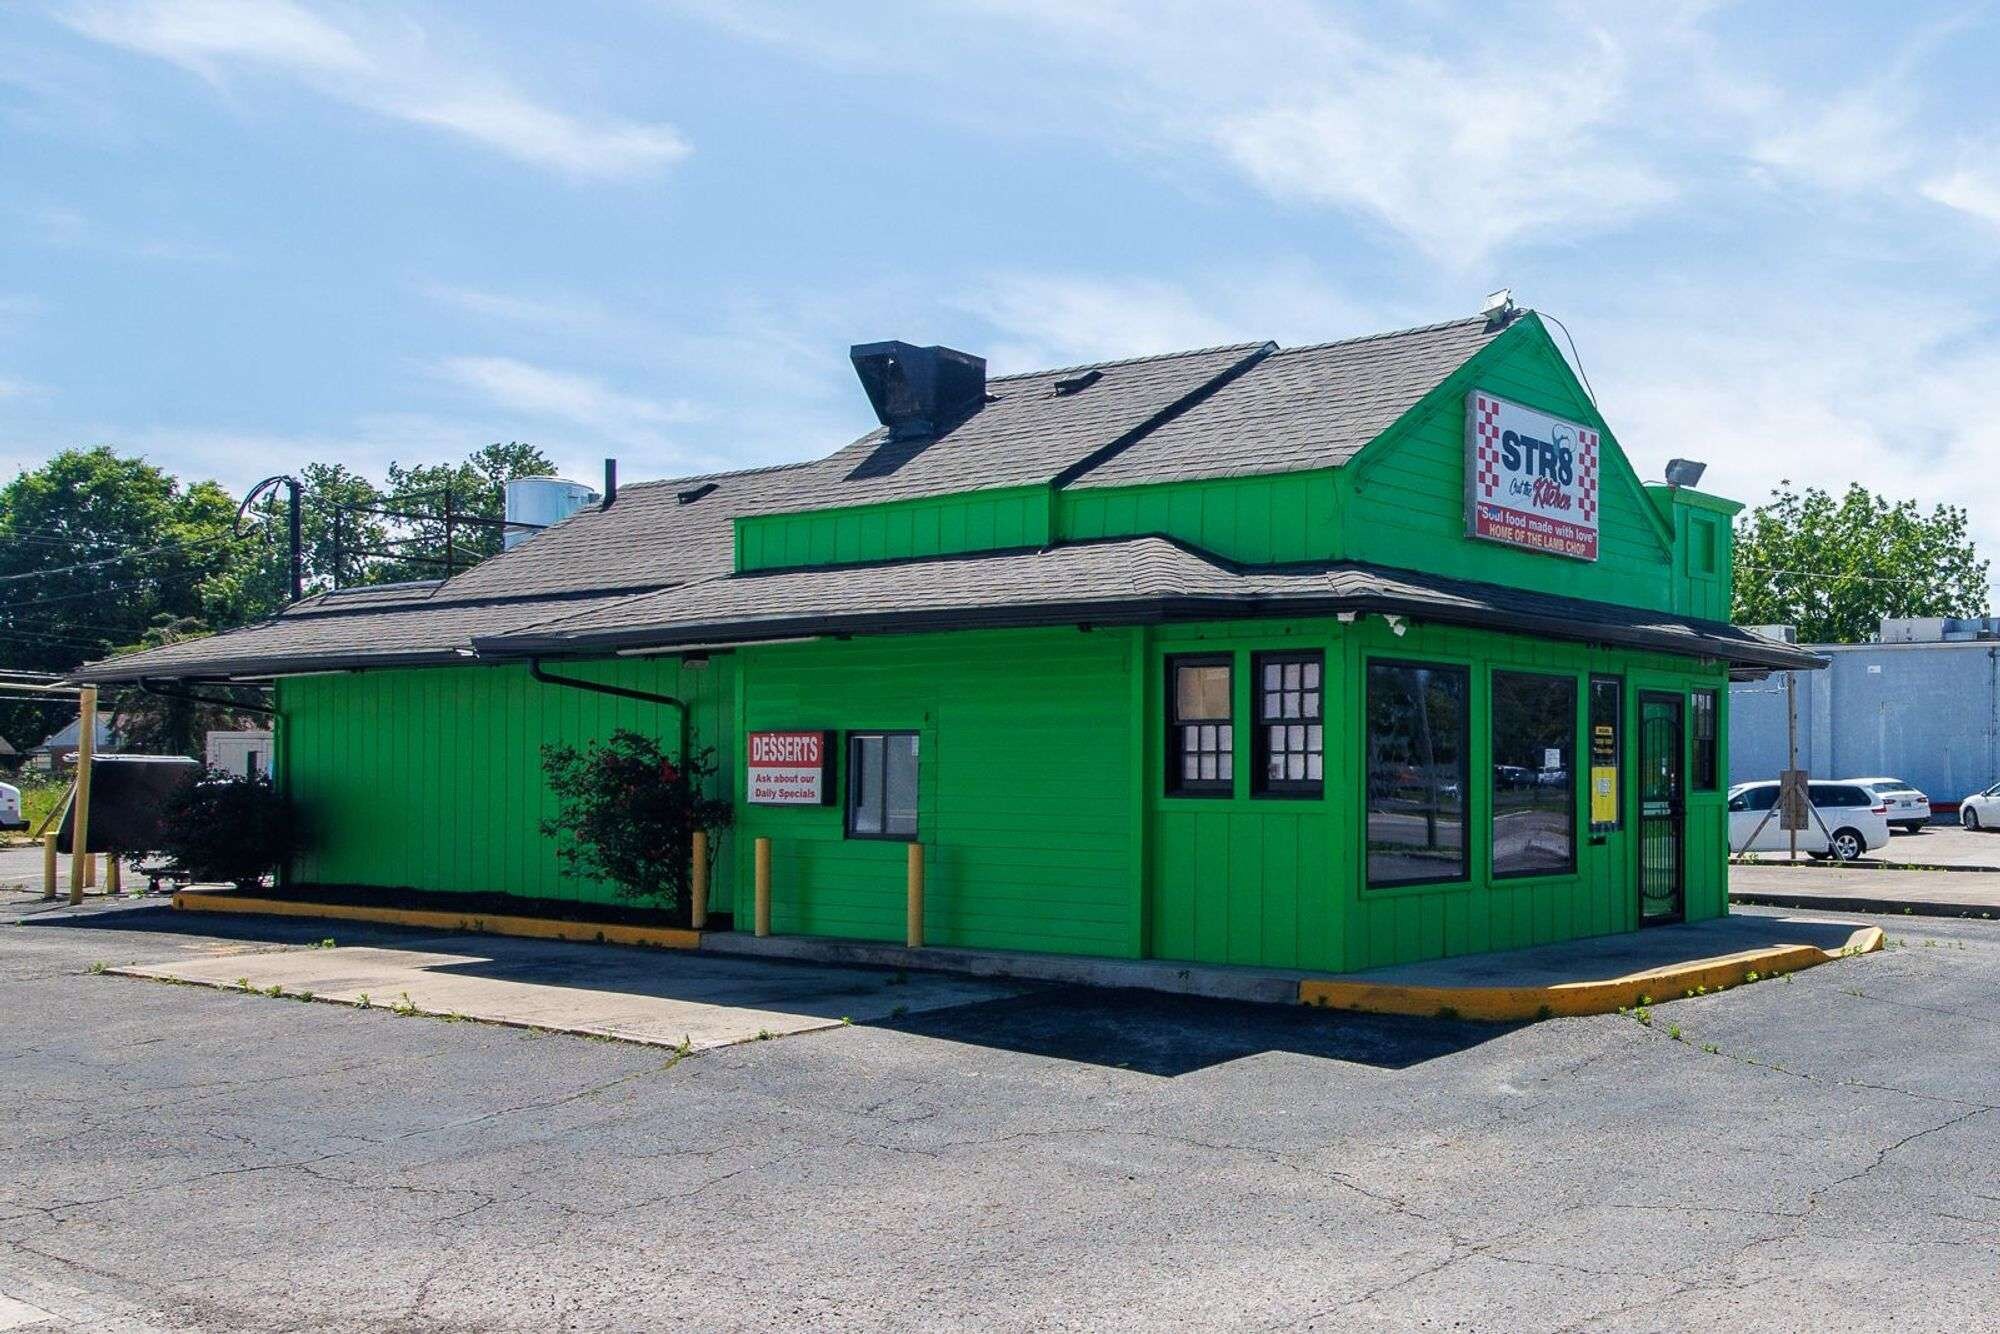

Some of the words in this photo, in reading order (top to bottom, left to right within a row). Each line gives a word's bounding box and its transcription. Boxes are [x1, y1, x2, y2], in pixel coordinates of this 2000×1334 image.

[1501, 430, 1573, 487] STR8
[1506, 511, 1526, 527] food
[1529, 519, 1553, 534] made
[1555, 525, 1574, 539] with
[1489, 523, 1513, 540] HOME
[1514, 529, 1526, 542] OF
[1527, 531, 1543, 546] THE
[1543, 535, 1564, 551] LAMB
[1565, 540, 1586, 555] CHOP
[752, 736, 818, 762] DESSERTS
[755, 774, 771, 783] Ask
[773, 774, 798, 783] about
[800, 775, 815, 783] our
[755, 788, 777, 800] Daily
[779, 788, 816, 800] Specials
